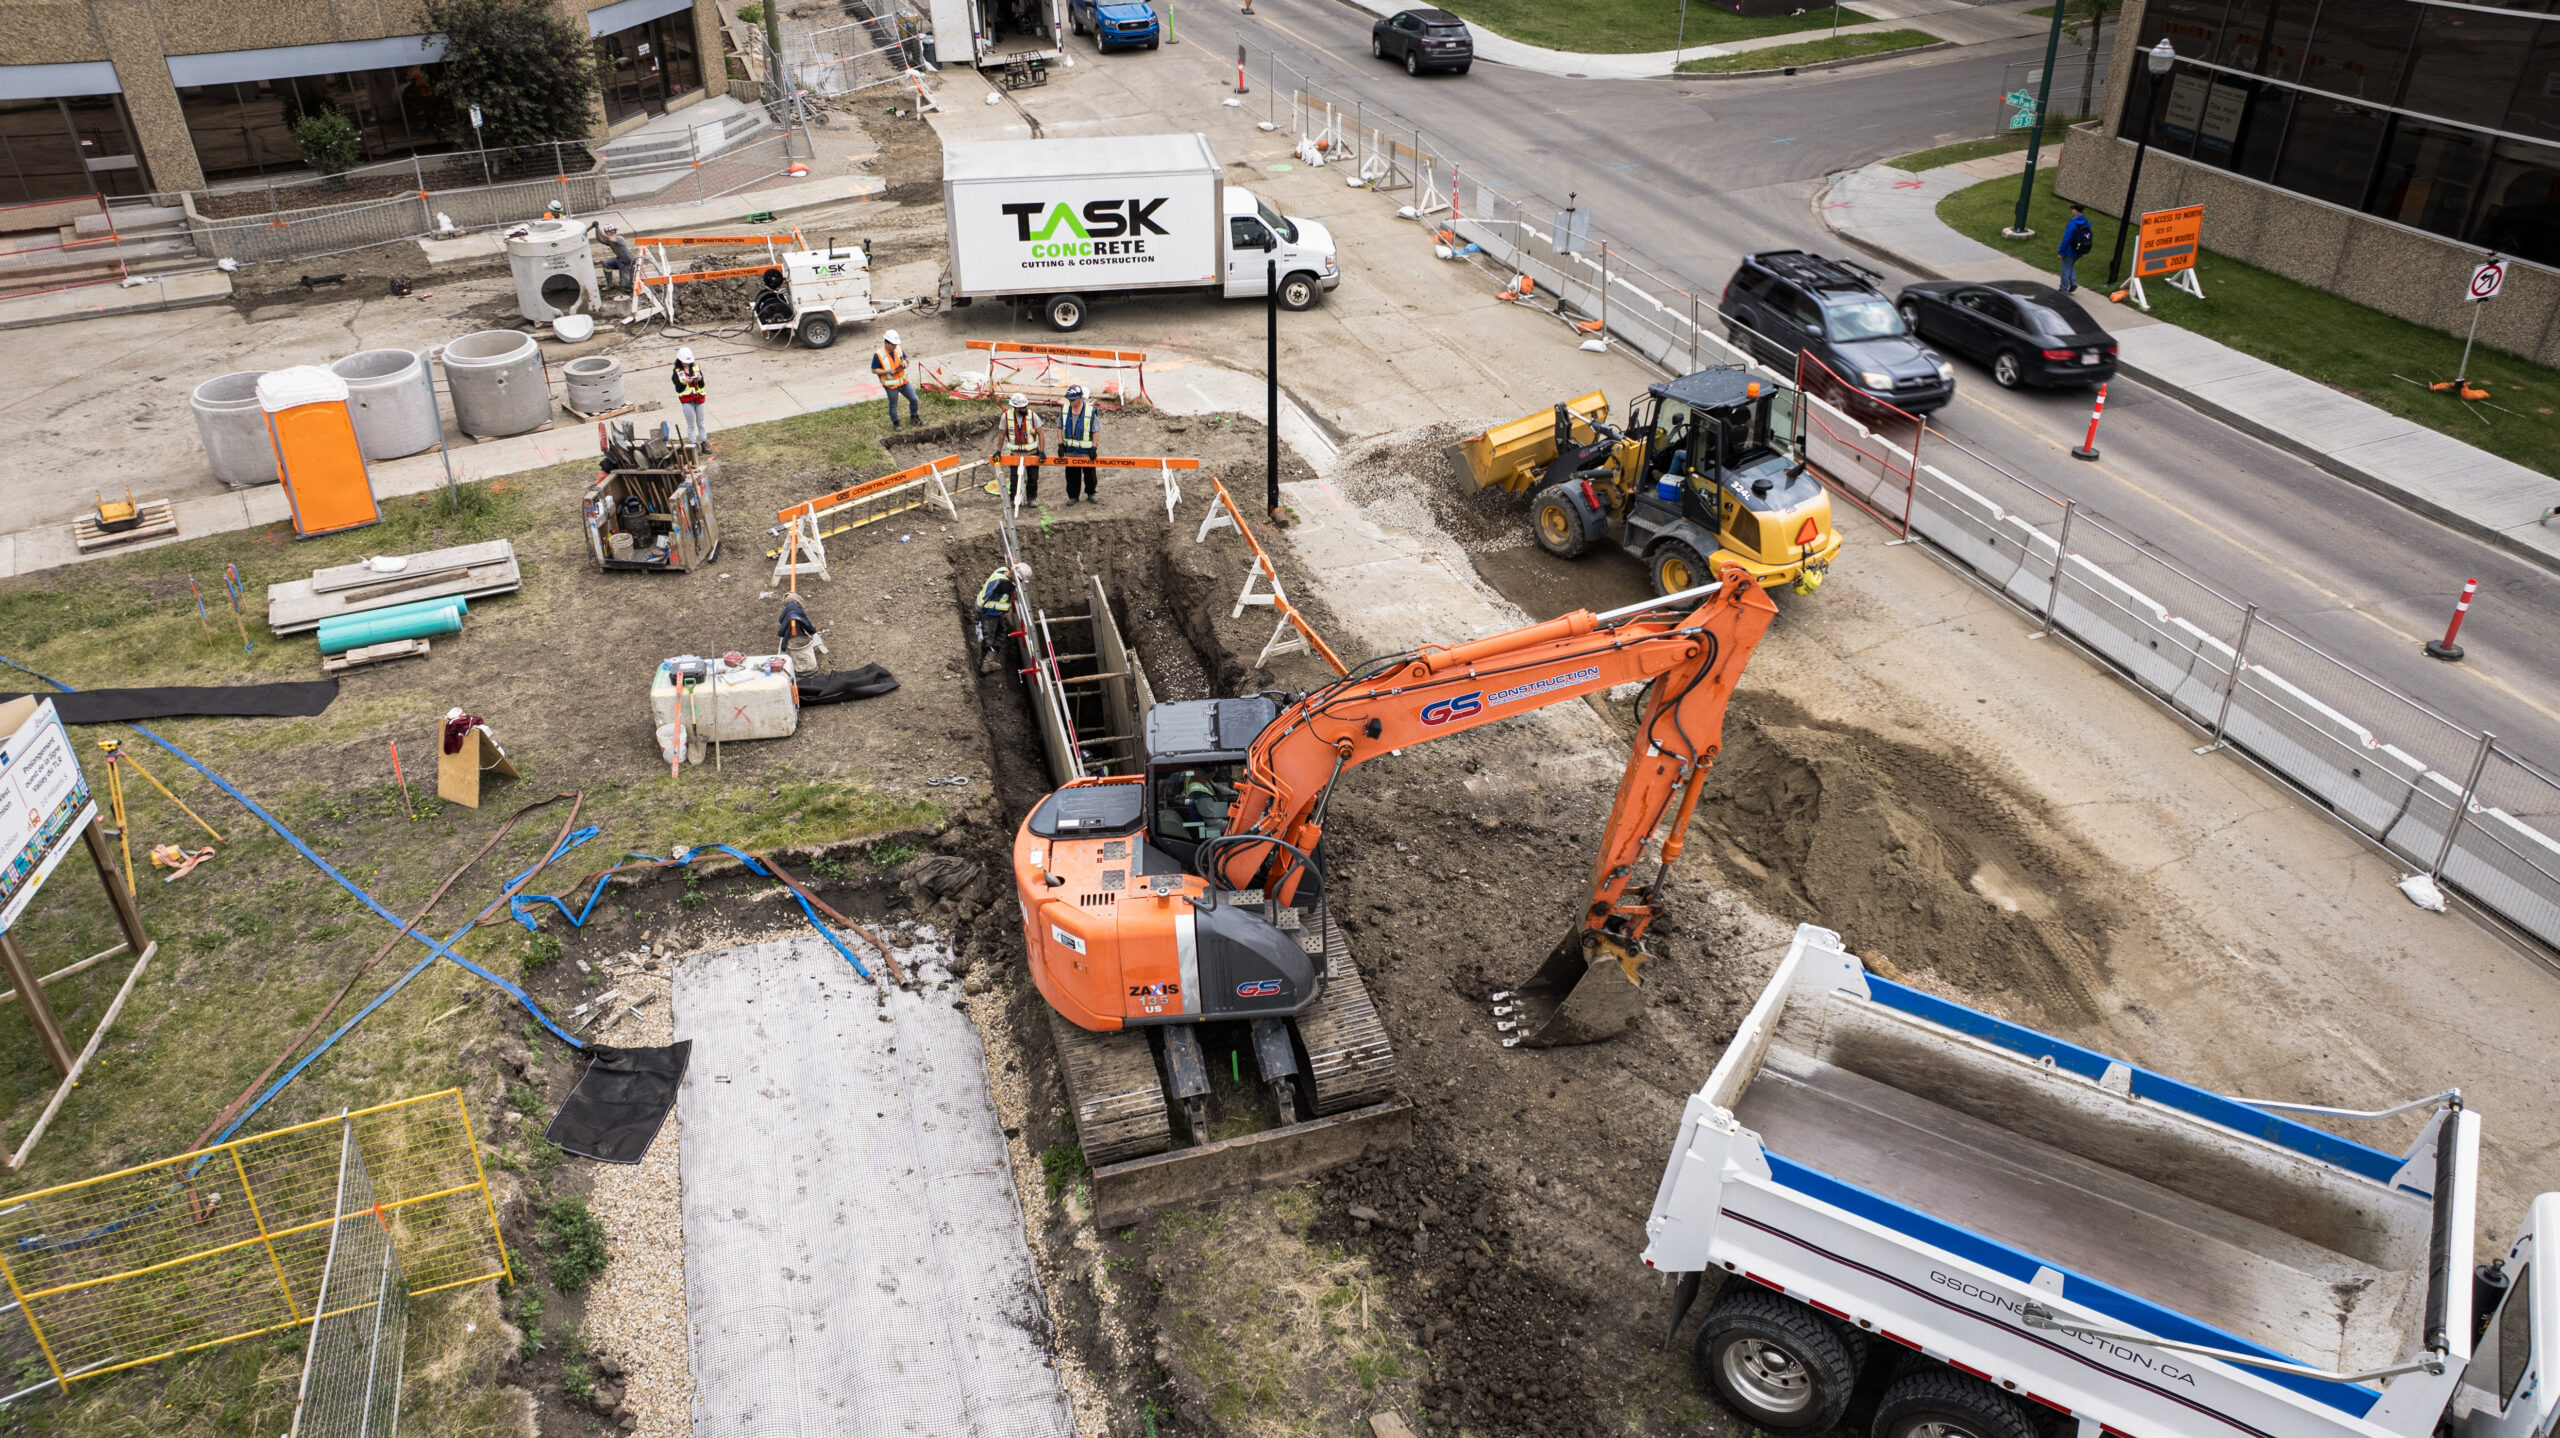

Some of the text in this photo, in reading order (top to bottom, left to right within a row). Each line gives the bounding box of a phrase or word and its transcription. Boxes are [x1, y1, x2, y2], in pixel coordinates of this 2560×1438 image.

[2013, 116, 2033, 127] 123 ST
[1002, 197, 1170, 241] TASK
[2154, 214, 2173, 224] ACCESS
[2174, 212, 2182, 220] TO
[2183, 210, 2202, 219] NORTH
[2144, 233, 2195, 248] USE OTHER ROUTES
[1031, 240, 1145, 258] CONCRETE
[1021, 259, 1065, 269] CUTTING
[1079, 256, 1155, 266] CONSTRUCTION
[2170, 256, 2188, 266] 2024
[708, 268, 758, 278] CONSTRUCTION
[812, 264, 846, 275] TASK
[1036, 347, 1091, 356] CONSTRUCTION
[836, 474, 907, 501] GS CONSTRUCTION
[1730, 480, 1751, 501] 324L
[1420, 666, 1600, 727] GS CONSTRUCTION
[23, 736, 56, 774] Prolongement
[25, 770, 38, 788] ouest
[48, 745, 61, 760] ligne
[32, 756, 63, 792] Valley du TLR
[1129, 982, 1180, 997] ZAXIS
[1236, 979, 1283, 998] GS
[1138, 995, 1170, 1007] 135
[1144, 1004, 1163, 1013] US
[1930, 1270, 2196, 1387] GSCONSUCTION.CA
